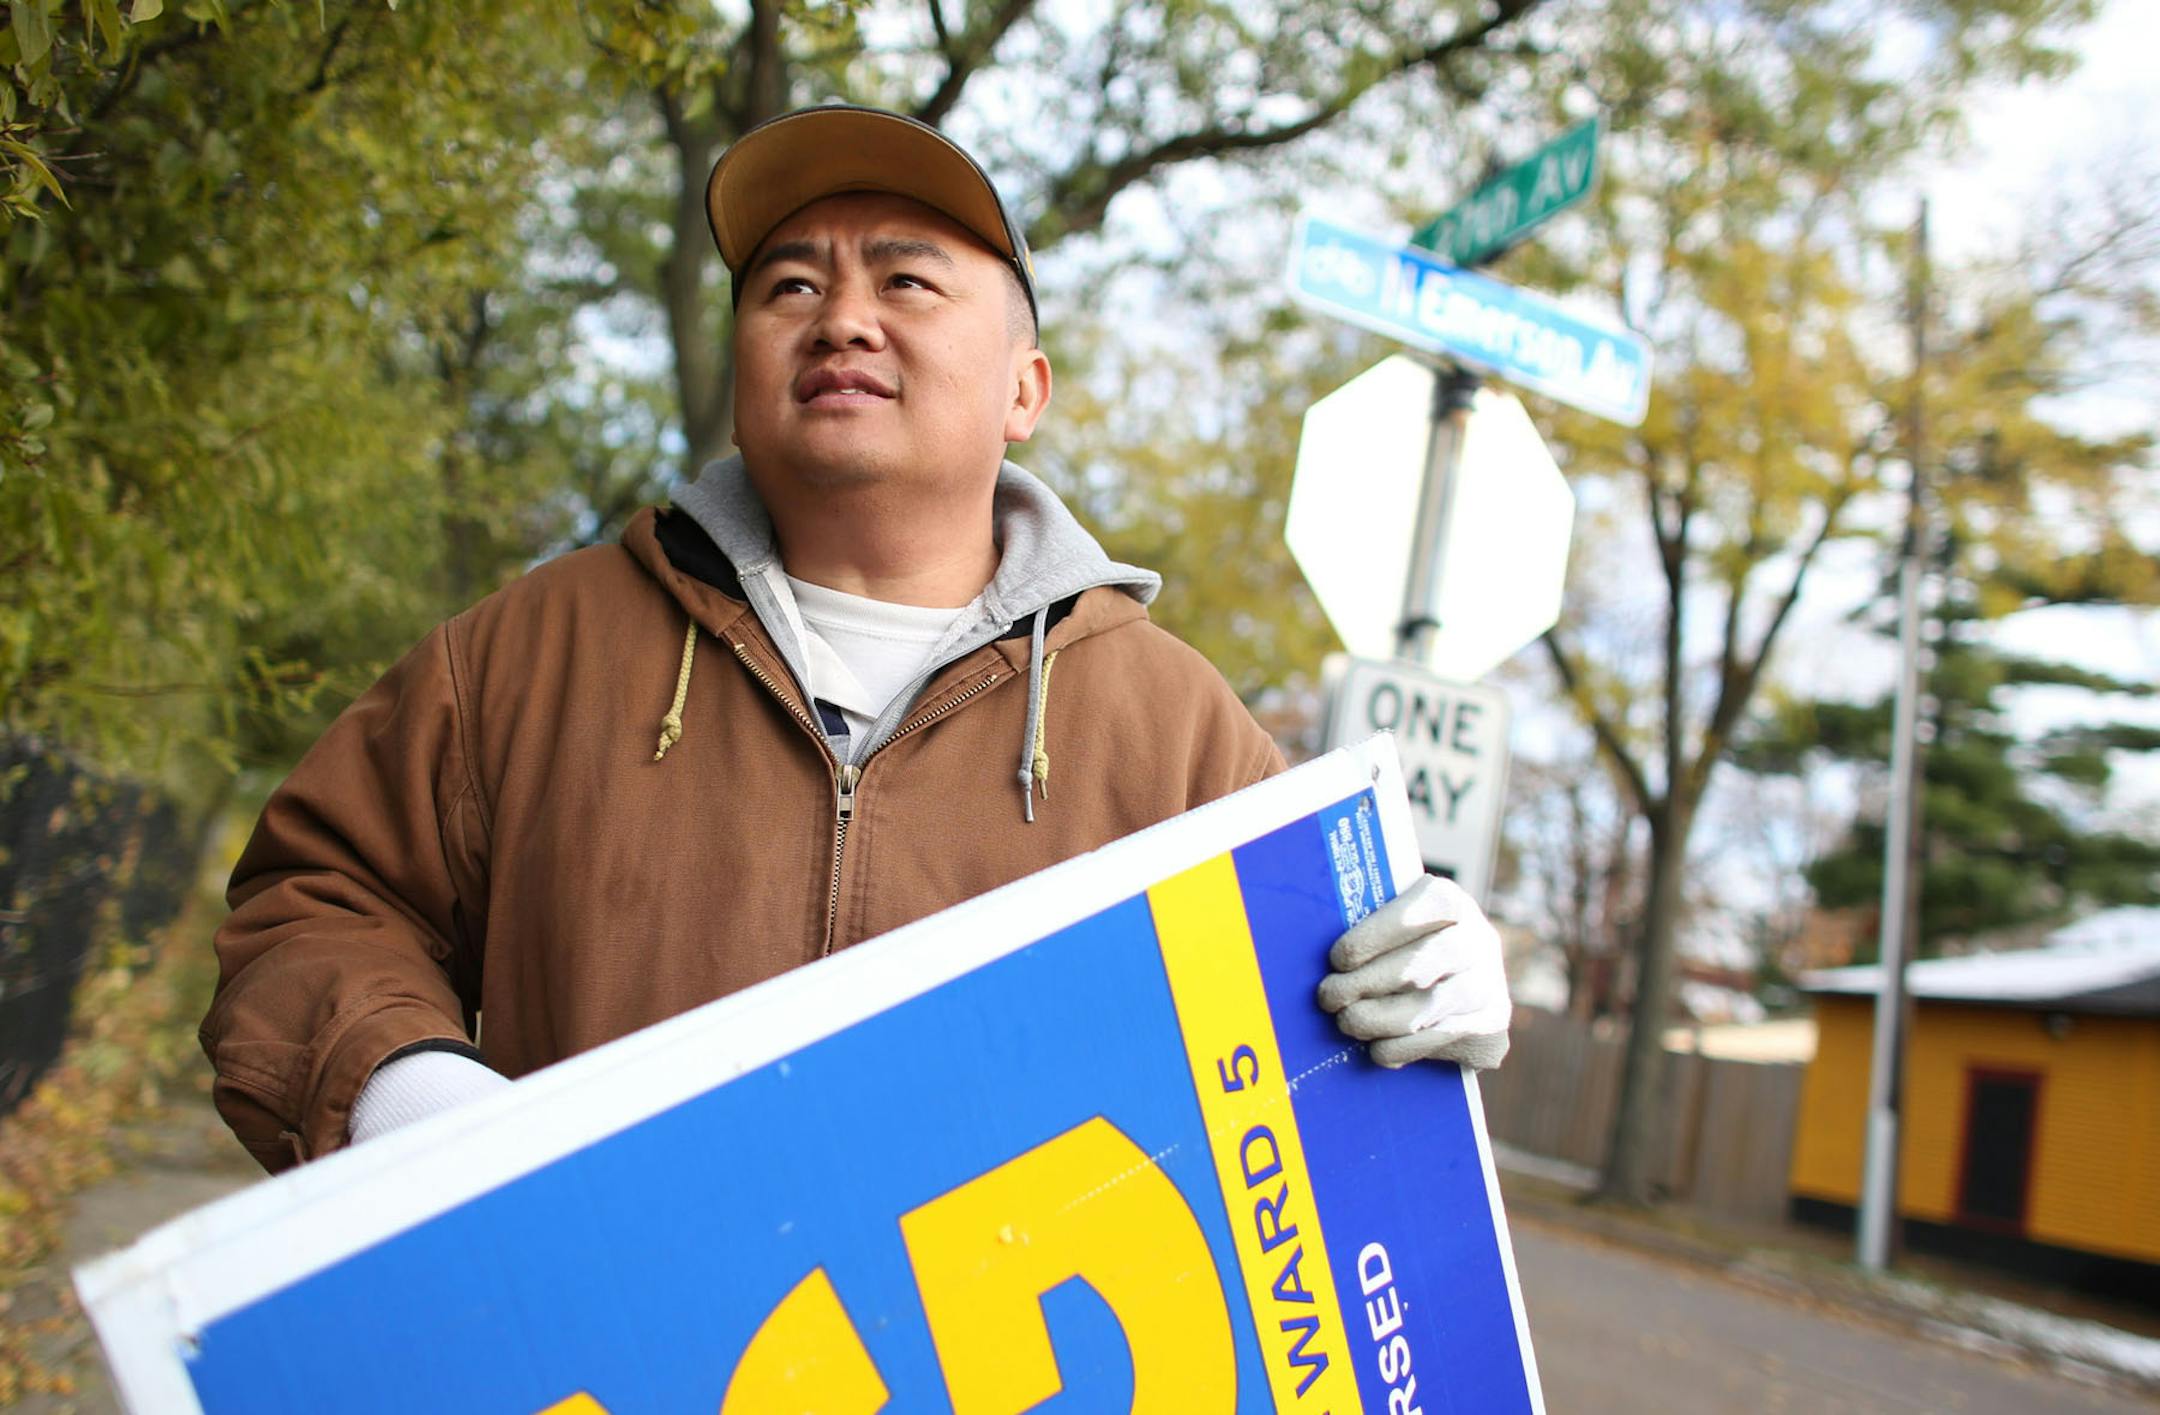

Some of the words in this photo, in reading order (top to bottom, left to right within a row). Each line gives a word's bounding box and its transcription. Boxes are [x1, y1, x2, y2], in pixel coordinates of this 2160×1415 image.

[1527, 148, 1592, 214] Av
[1379, 255, 1419, 318] N
[1418, 271, 1584, 384] Emerson
[1366, 681, 1486, 756] ONE
[1406, 765, 1477, 823] AY
[1216, 1043, 1260, 1094] 5
[1239, 1124, 1330, 1400] WARD
